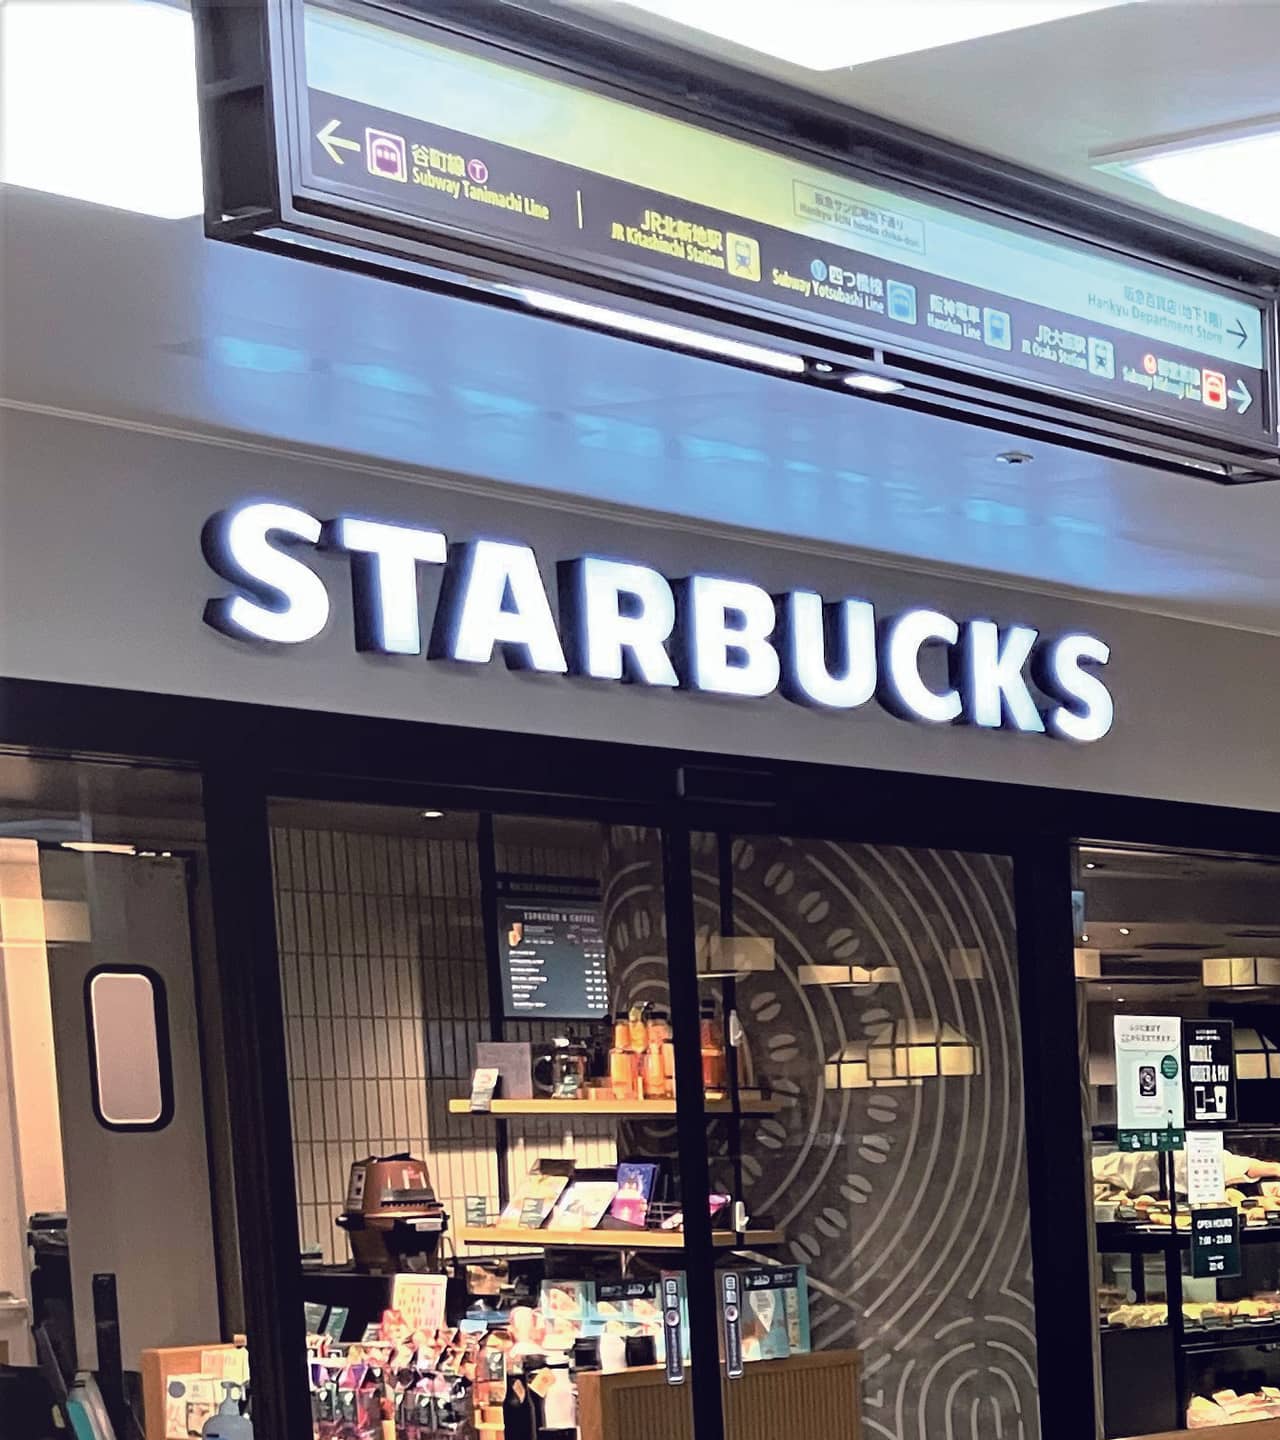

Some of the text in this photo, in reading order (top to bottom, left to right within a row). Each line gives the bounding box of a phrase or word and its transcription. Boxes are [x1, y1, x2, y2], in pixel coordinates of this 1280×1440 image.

[412, 168, 549, 220] Subway Tanimachi Line
[686, 245, 725, 269] Station
[772, 268, 885, 314] Subway Yotsubashi Line
[963, 323, 981, 341] Line
[1088, 293, 1223, 344] Hankyu Department Store
[1032, 342, 1058, 362] Osaka
[205, 500, 1116, 744] STARBUCKS
